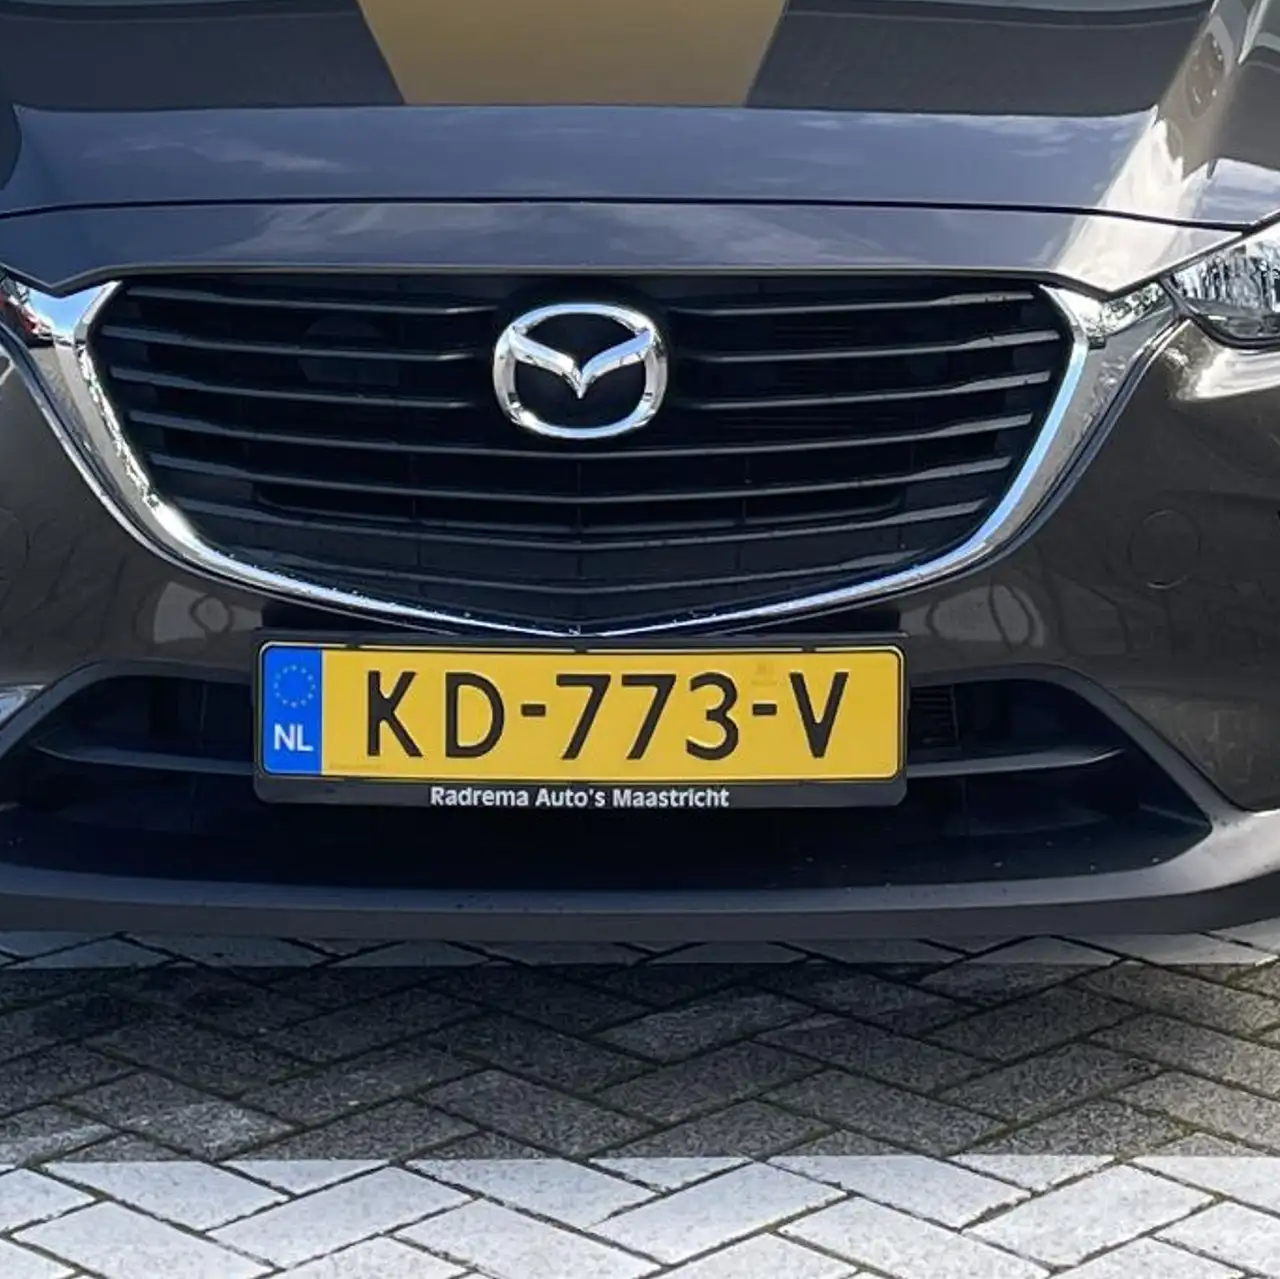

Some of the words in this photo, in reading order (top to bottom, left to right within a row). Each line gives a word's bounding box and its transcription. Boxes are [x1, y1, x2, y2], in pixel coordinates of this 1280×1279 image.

[272, 723, 314, 753] NL
[365, 669, 849, 761] KD-773-V
[429, 786, 529, 808] Radrema
[535, 787, 606, 809] Auto's
[611, 787, 730, 809] Maastricht
